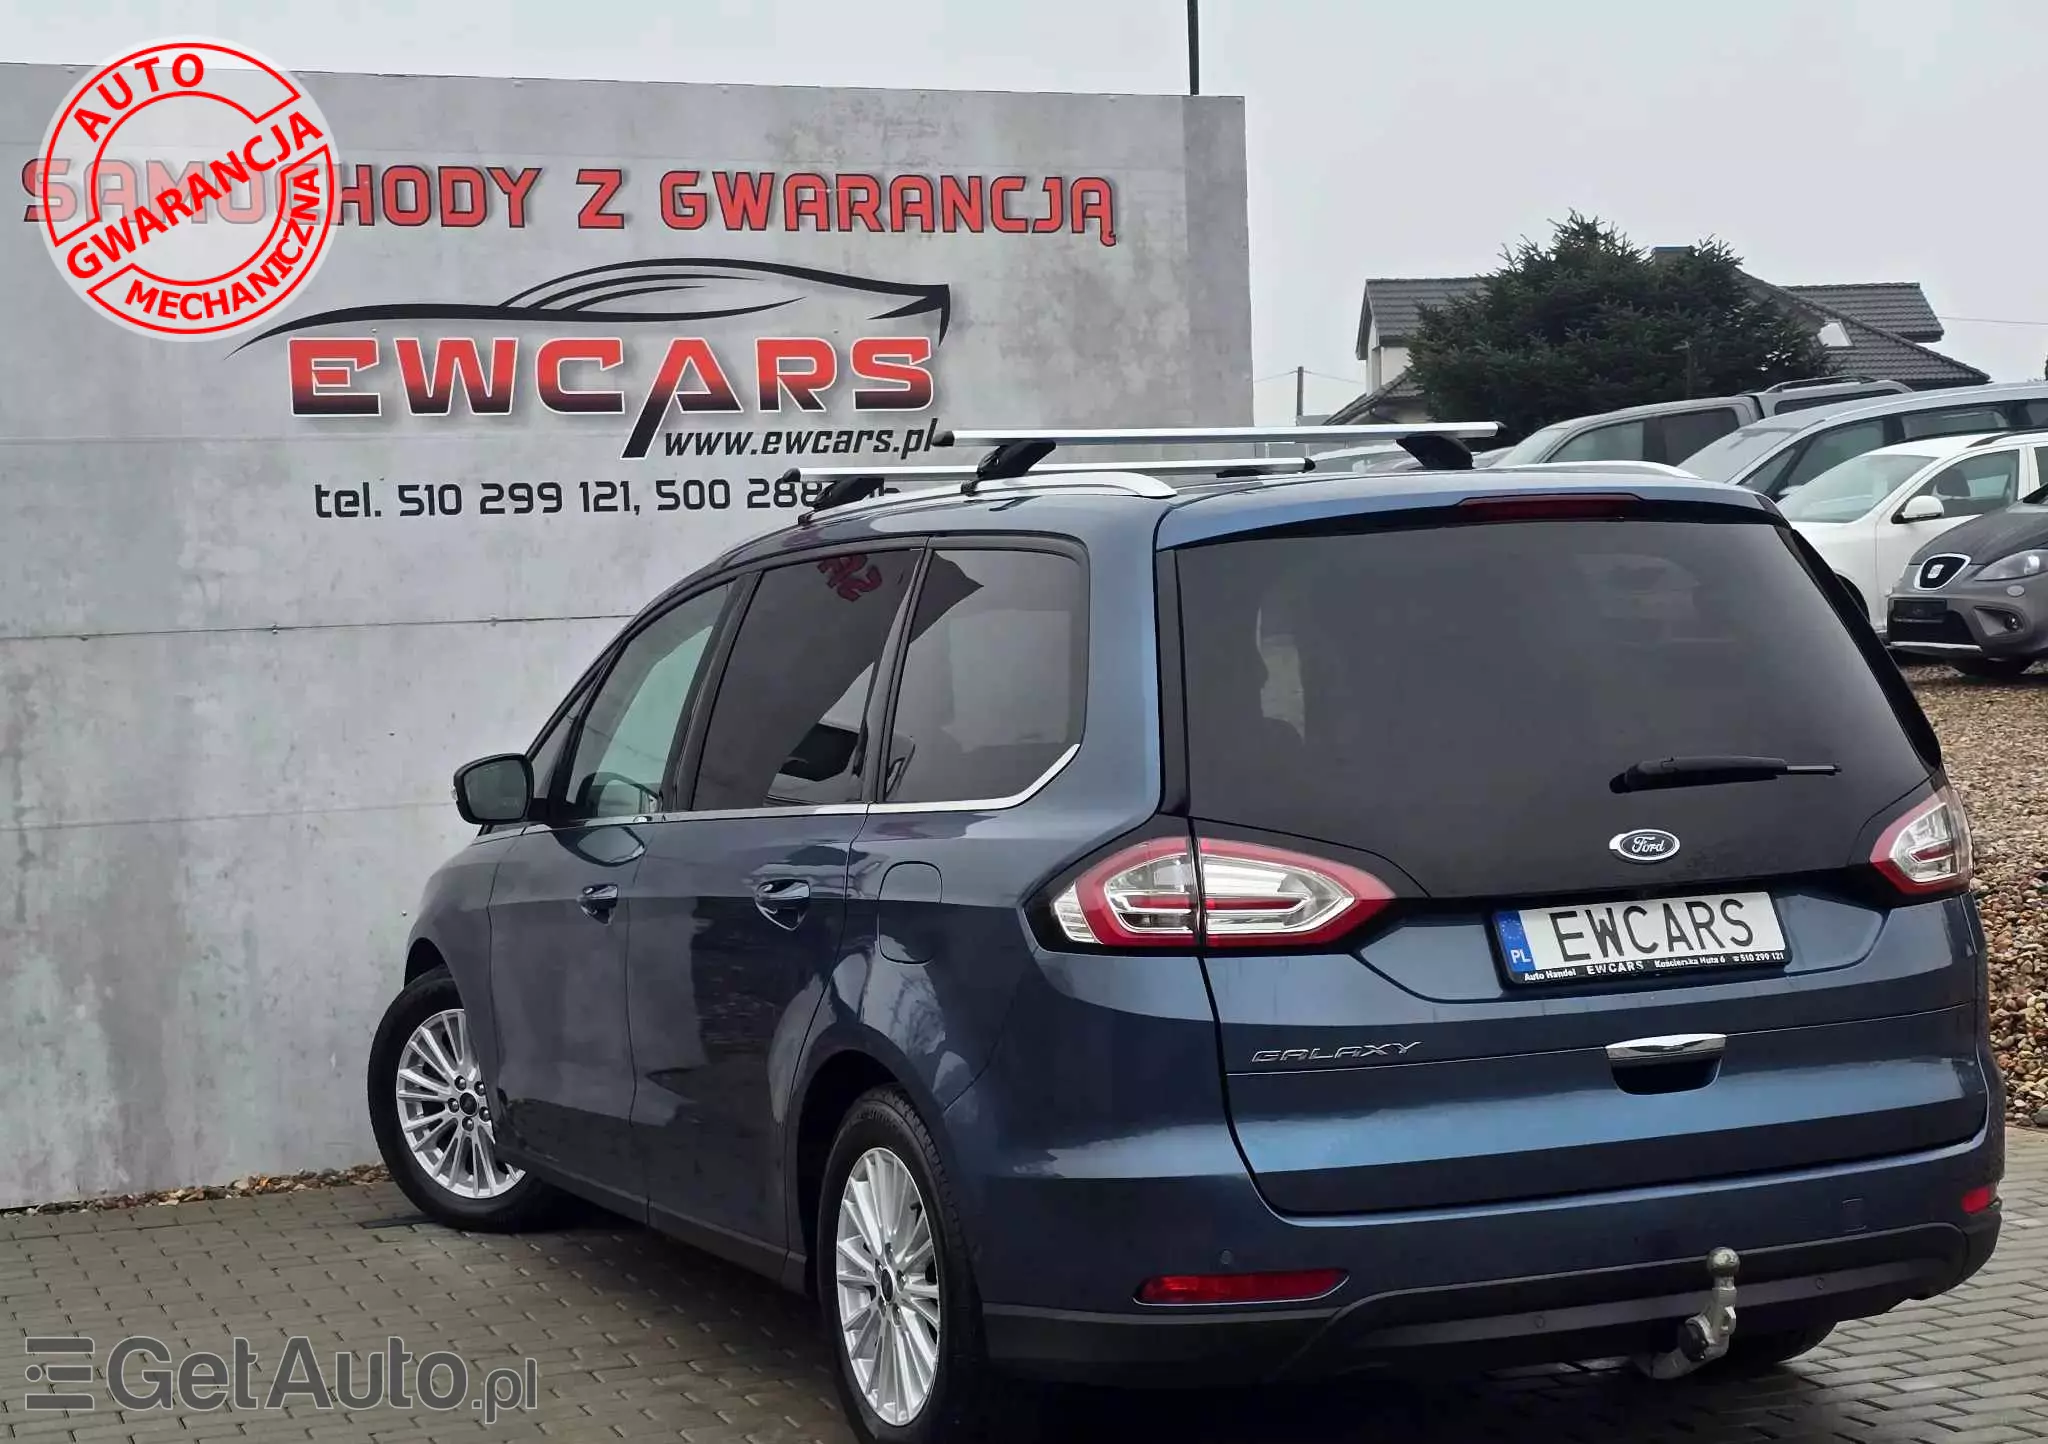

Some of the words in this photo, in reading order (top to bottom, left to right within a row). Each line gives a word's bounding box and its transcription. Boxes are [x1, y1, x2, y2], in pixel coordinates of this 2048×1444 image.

[21, 158, 542, 228] SAMOCHODY
[576, 168, 624, 230] Z
[659, 170, 1116, 247] GWARANCJĄ
[287, 336, 934, 460] EWCARS
[665, 417, 939, 460] www.ewcars.pl
[314, 481, 382, 518] tel.
[397, 483, 463, 517] 510
[479, 482, 563, 515] 299
[578, 481, 641, 516] 121,
[655, 479, 731, 511] 500
[1632, 836, 1666, 854] Ford
[1549, 899, 1754, 962] EWCARS
[1510, 949, 1532, 964] PL
[1524, 971, 1545, 982] Auto
[1546, 968, 1577, 979] Handel
[1586, 960, 1644, 975] EWCARS
[1251, 1041, 1422, 1063] GALAXY
